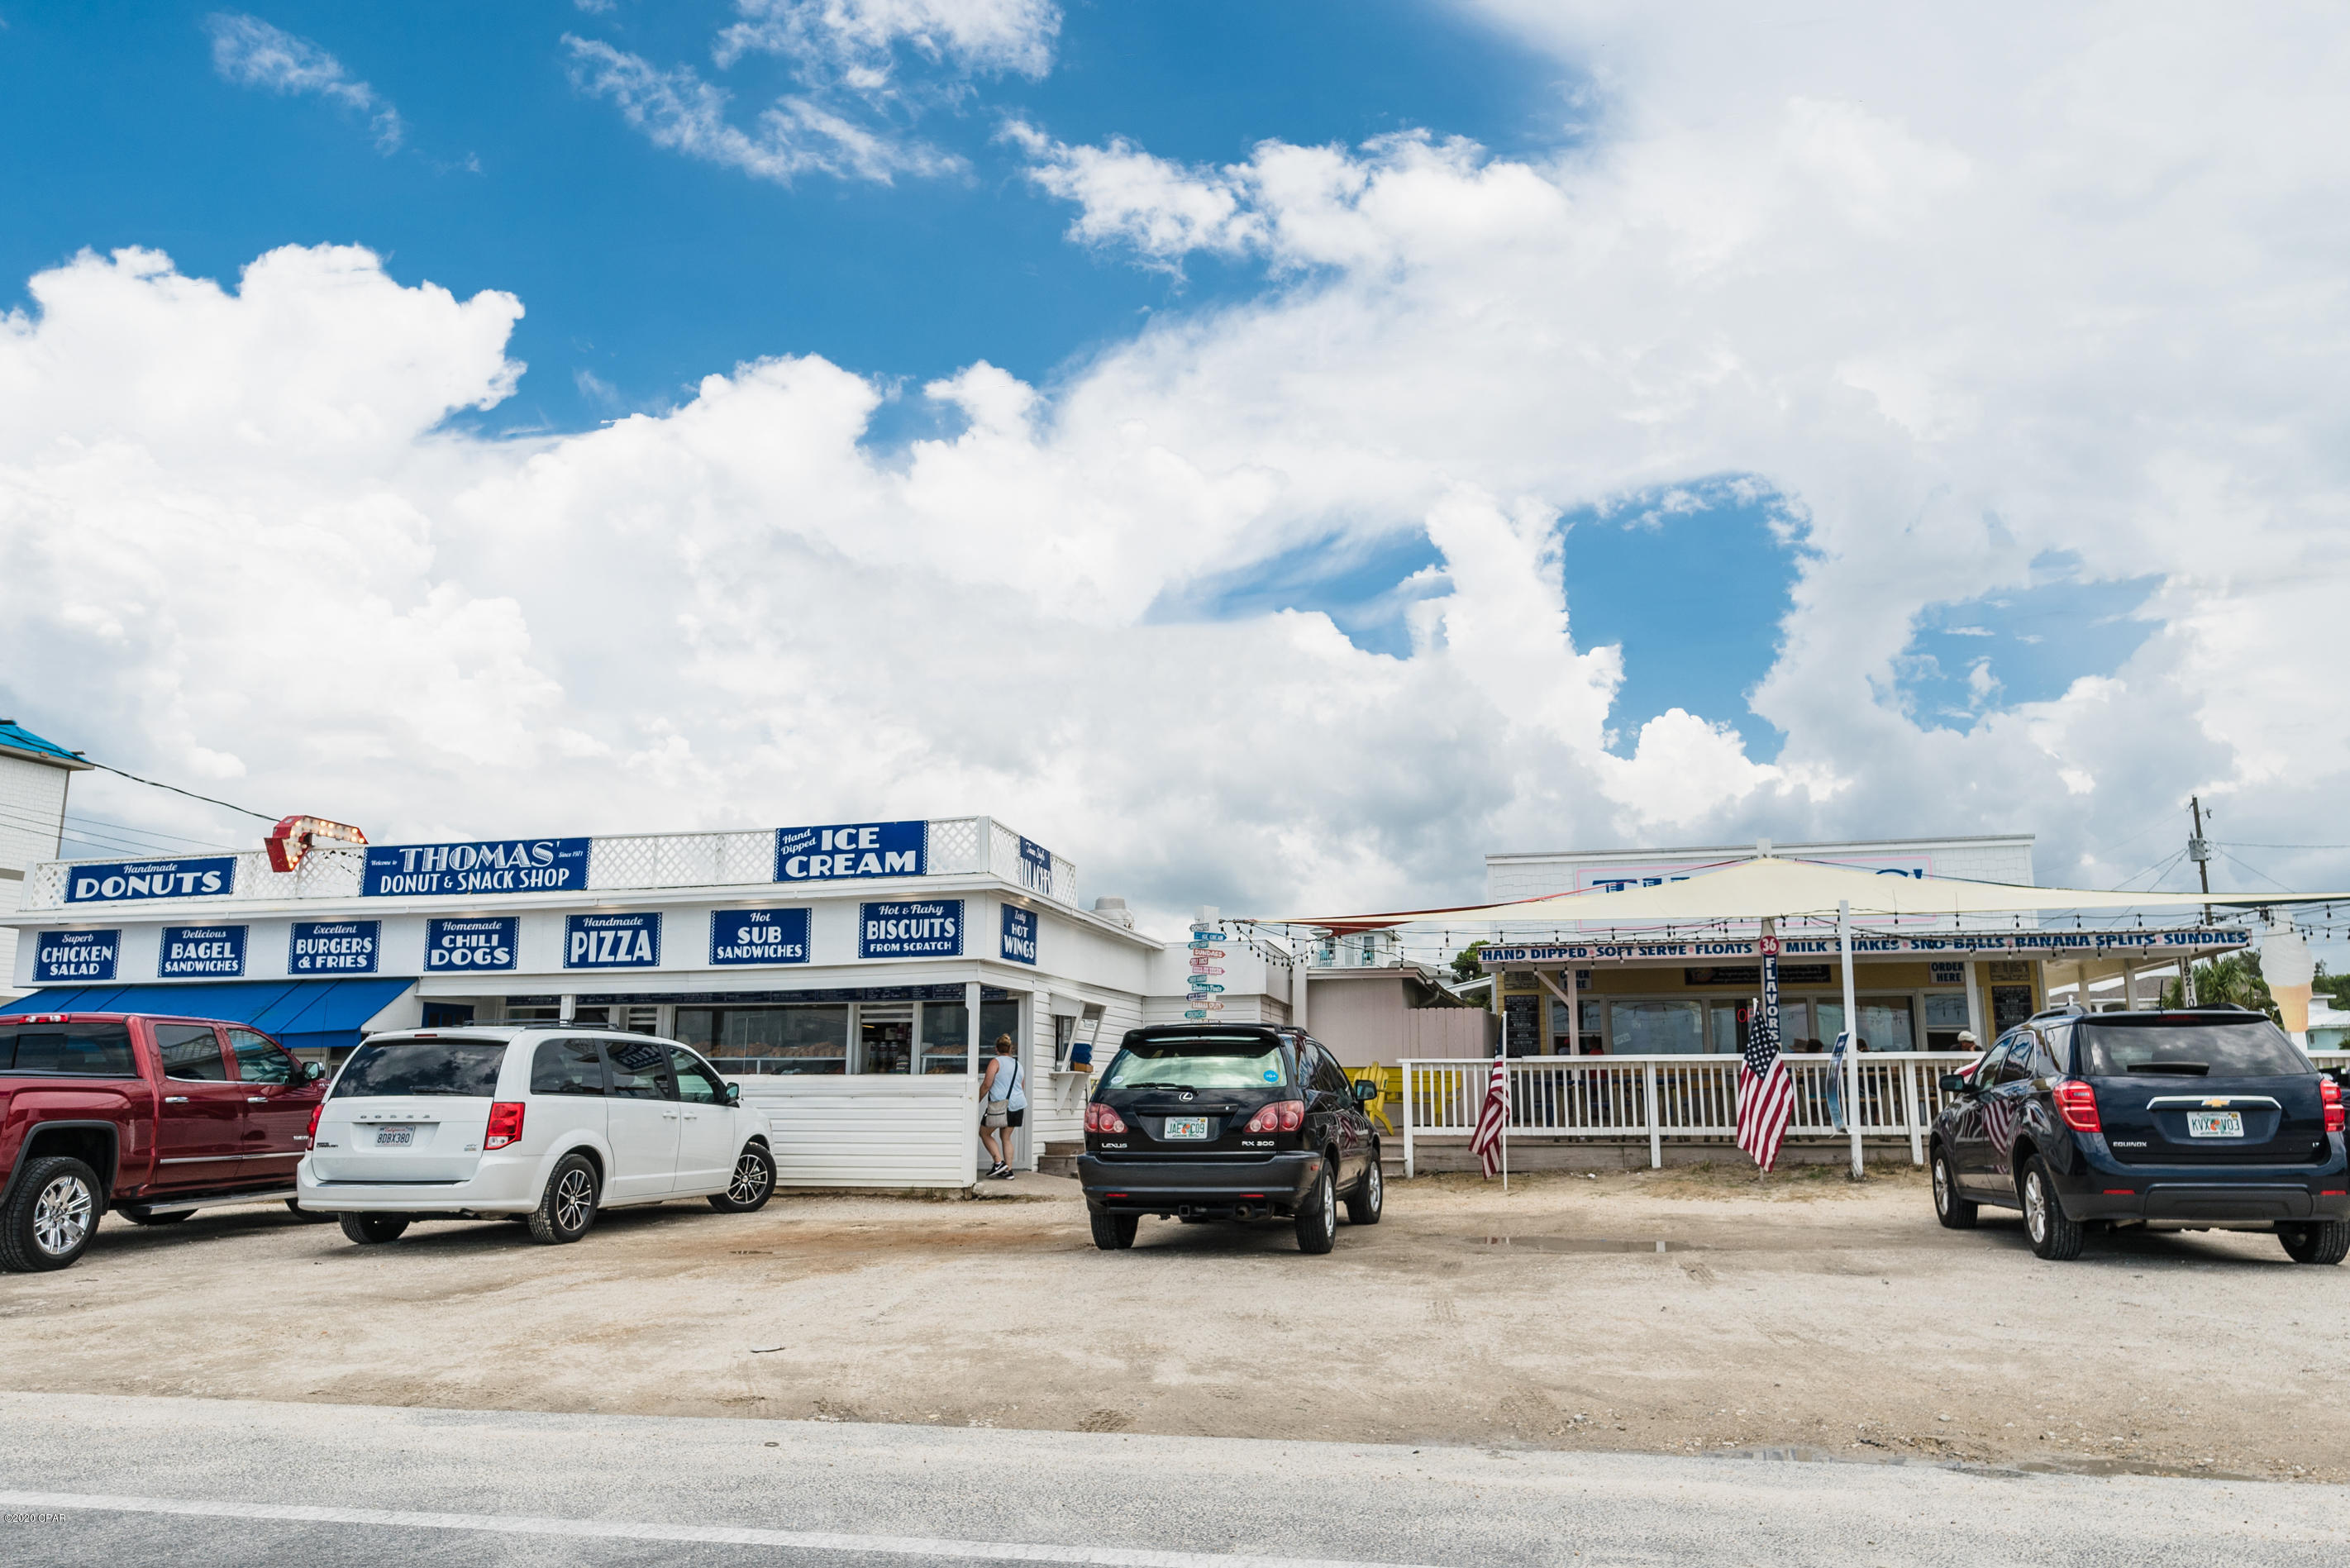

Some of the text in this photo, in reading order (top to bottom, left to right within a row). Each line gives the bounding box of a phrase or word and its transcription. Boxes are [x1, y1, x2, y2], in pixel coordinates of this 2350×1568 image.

[782, 828, 811, 844] Hand
[821, 827, 880, 851] ICE
[780, 836, 817, 855] Dipped
[399, 841, 560, 872] THOMAS'
[123, 862, 178, 875] Handmade
[784, 851, 917, 878] CREAM
[74, 870, 222, 899] DONUTS
[380, 867, 570, 894] DONUT & SNACK SHOP
[750, 912, 771, 922] Hot
[879, 903, 945, 917] Hot & Flaky
[1014, 910, 1026, 923] Zesty
[313, 923, 357, 935] Excellent
[442, 921, 502, 931] Homemade
[583, 917, 643, 927] Handmade
[866, 917, 956, 940] BISCUITS
[182, 928, 226, 939] Delicious
[736, 927, 782, 944] SUB
[1011, 923, 1029, 937] HOT
[62, 933, 94, 945] Superb
[296, 937, 373, 955] BURGERS
[441, 934, 498, 948] CHILI
[570, 929, 652, 963] PIZZA
[870, 941, 951, 952] FROM SCRATCH
[1762, 938, 1777, 952] 36
[1785, 941, 1828, 952] MILK
[1911, 937, 2004, 949] SNO-BALLS
[2015, 936, 2090, 947] BANANA
[2096, 934, 2156, 946] SPLITS
[2164, 932, 2248, 945] SUNDAES
[41, 945, 113, 963] CHICKEN
[170, 941, 236, 960] BAGEL
[717, 944, 803, 960] SANDWICHES
[1003, 935, 1035, 959] WINGS
[1482, 942, 1753, 960] HAND DIPPED SOFT SERVE FLOATS
[298, 954, 369, 969] & FRIES
[430, 947, 511, 966] DOGS
[49, 962, 100, 977] SALAD
[164, 959, 239, 973] SANDWICHES
[1931, 962, 1964, 972] ORDER
[1560, 970, 1590, 979] OER
[1936, 973, 1962, 982] HERE
[2183, 956, 2195, 1007] 19210
[1765, 957, 1780, 1041] FLAVORS
[1167, 1123, 1204, 1133] JAE C09
[2192, 1118, 2210, 1131] KVX
[377, 1133, 410, 1144] 8DBX380
